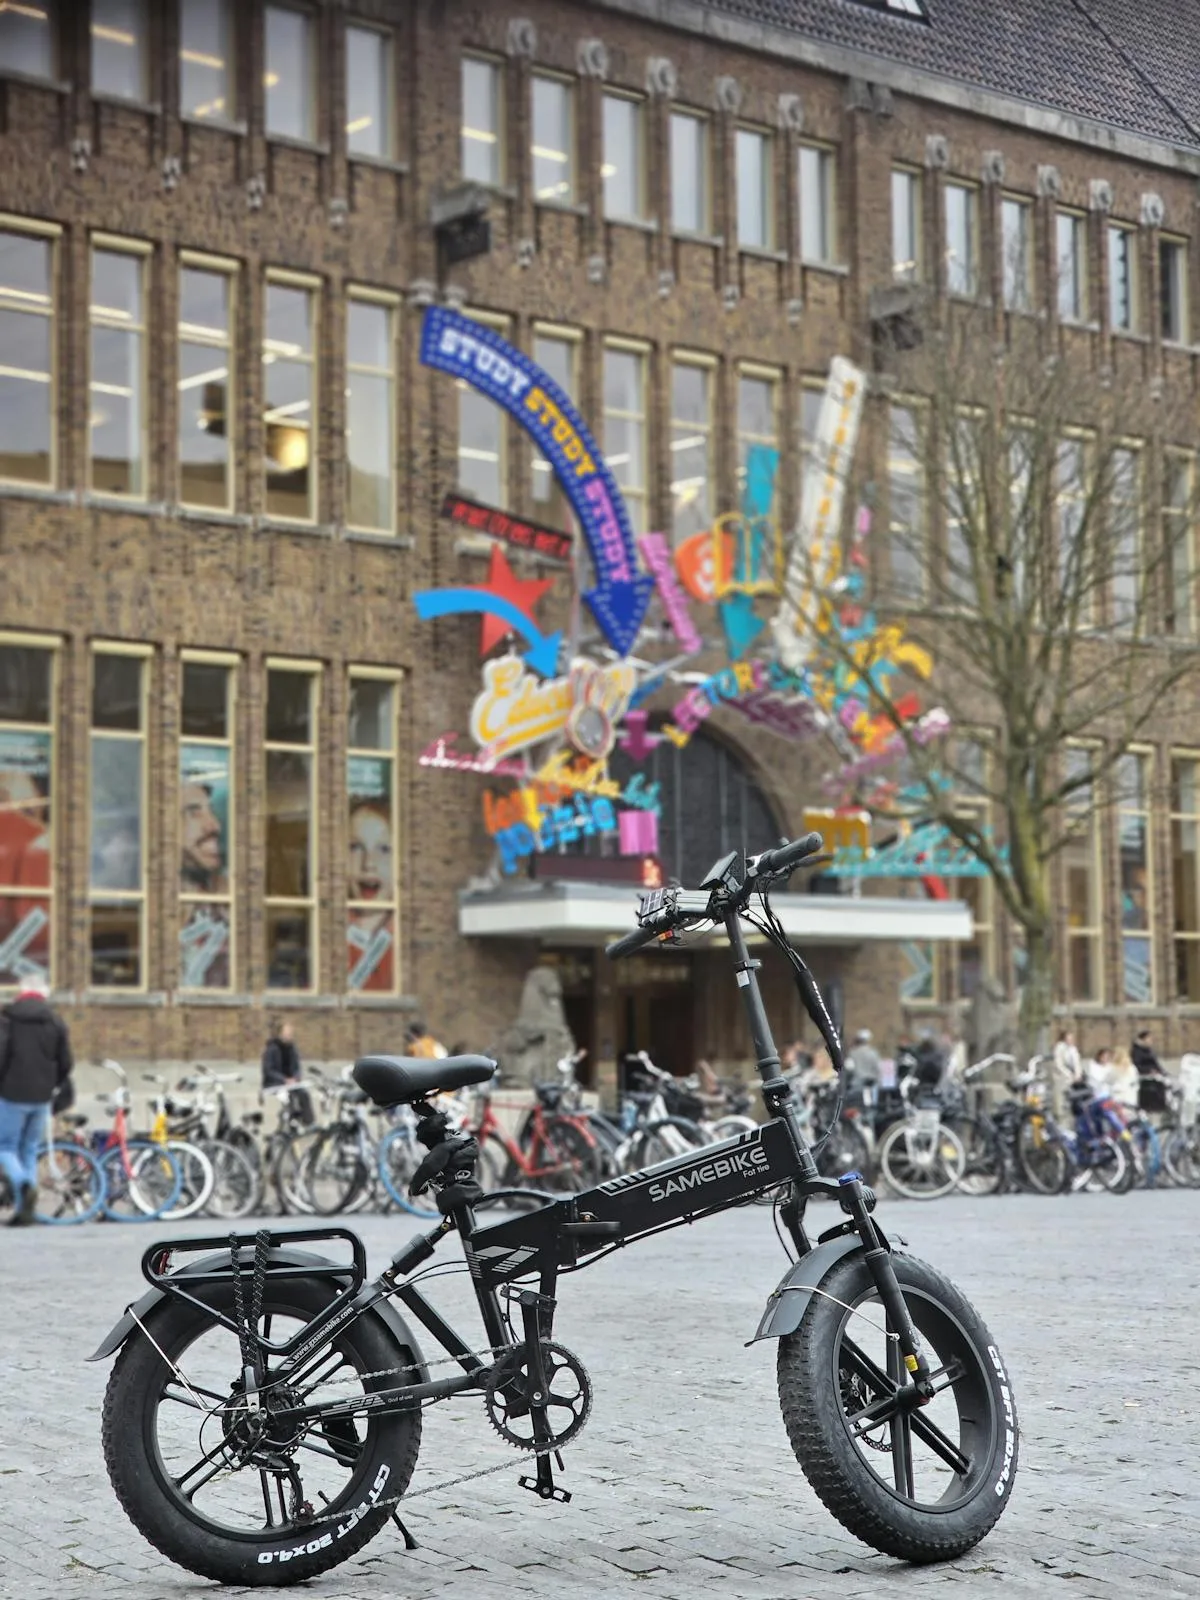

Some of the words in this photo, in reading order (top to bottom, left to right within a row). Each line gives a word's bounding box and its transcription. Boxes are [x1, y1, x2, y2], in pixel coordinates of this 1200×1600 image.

[440, 328, 530, 395] STUDY
[524, 387, 597, 477] STUDY
[585, 479, 631, 583] STUDY
[648, 1146, 767, 1202] SAMEBIKE
[743, 1168, 756, 1179] Fat
[757, 1164, 770, 1174] tire
[293, 1306, 354, 1361] www.gzsamebike.com
[987, 1345, 1006, 1382] CST
[1000, 1385, 1014, 1428] BFT
[368, 1464, 391, 1504] CST
